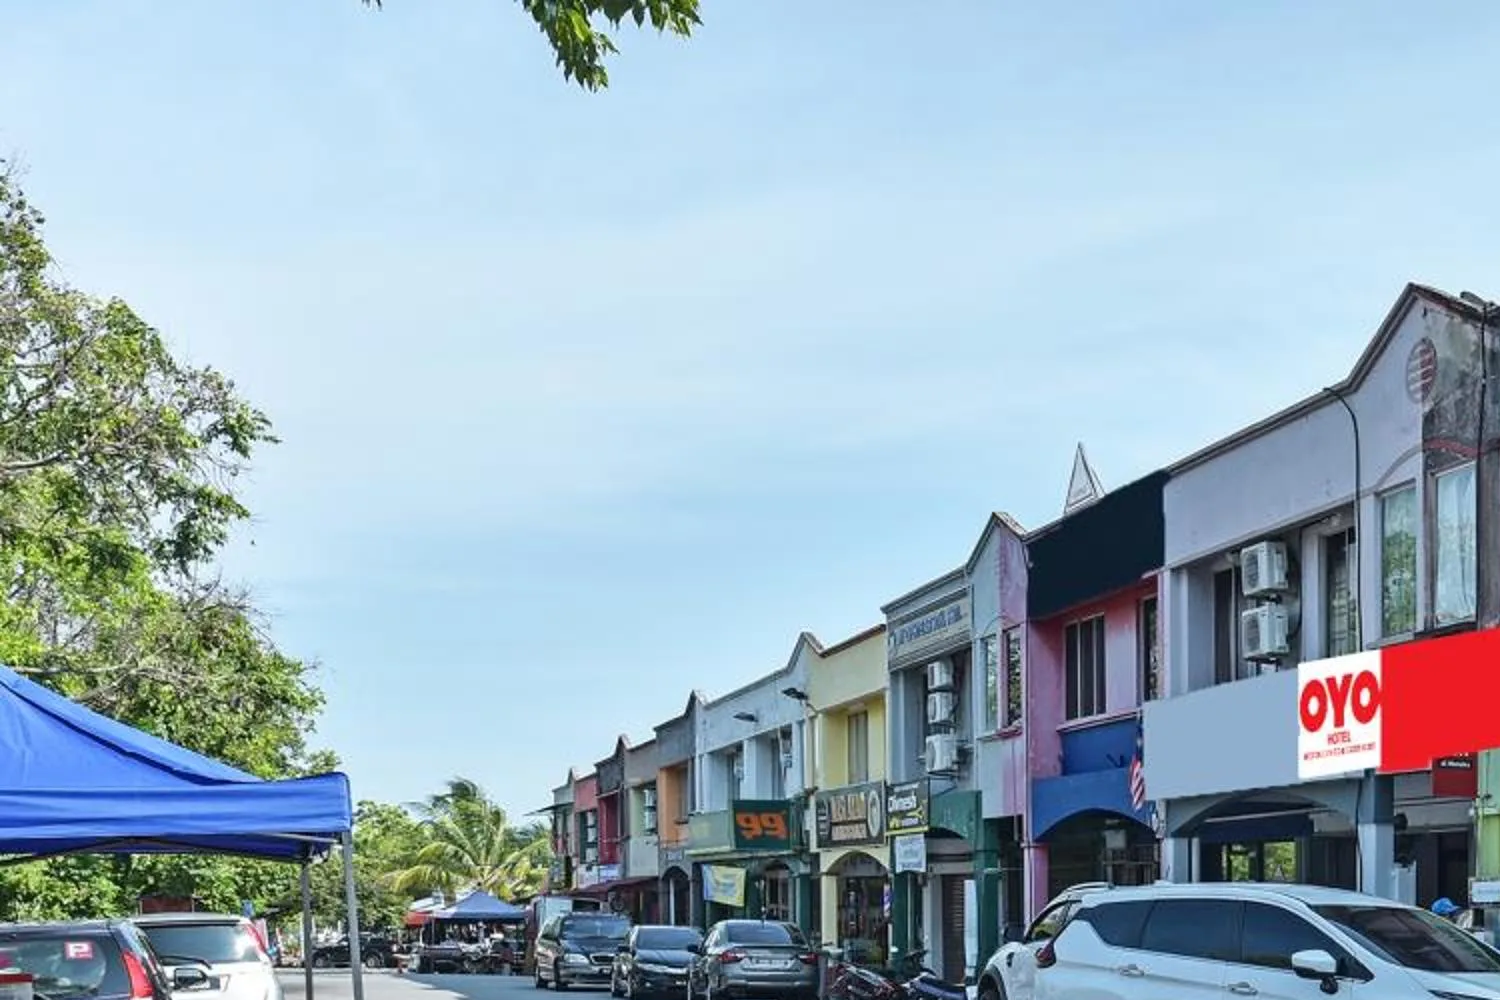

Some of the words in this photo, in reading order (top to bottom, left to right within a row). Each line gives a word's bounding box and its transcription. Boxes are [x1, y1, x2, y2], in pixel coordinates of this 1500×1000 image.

[1300, 670, 1379, 732] OYO
[736, 811, 788, 840] 99
[68, 942, 90, 959] P
